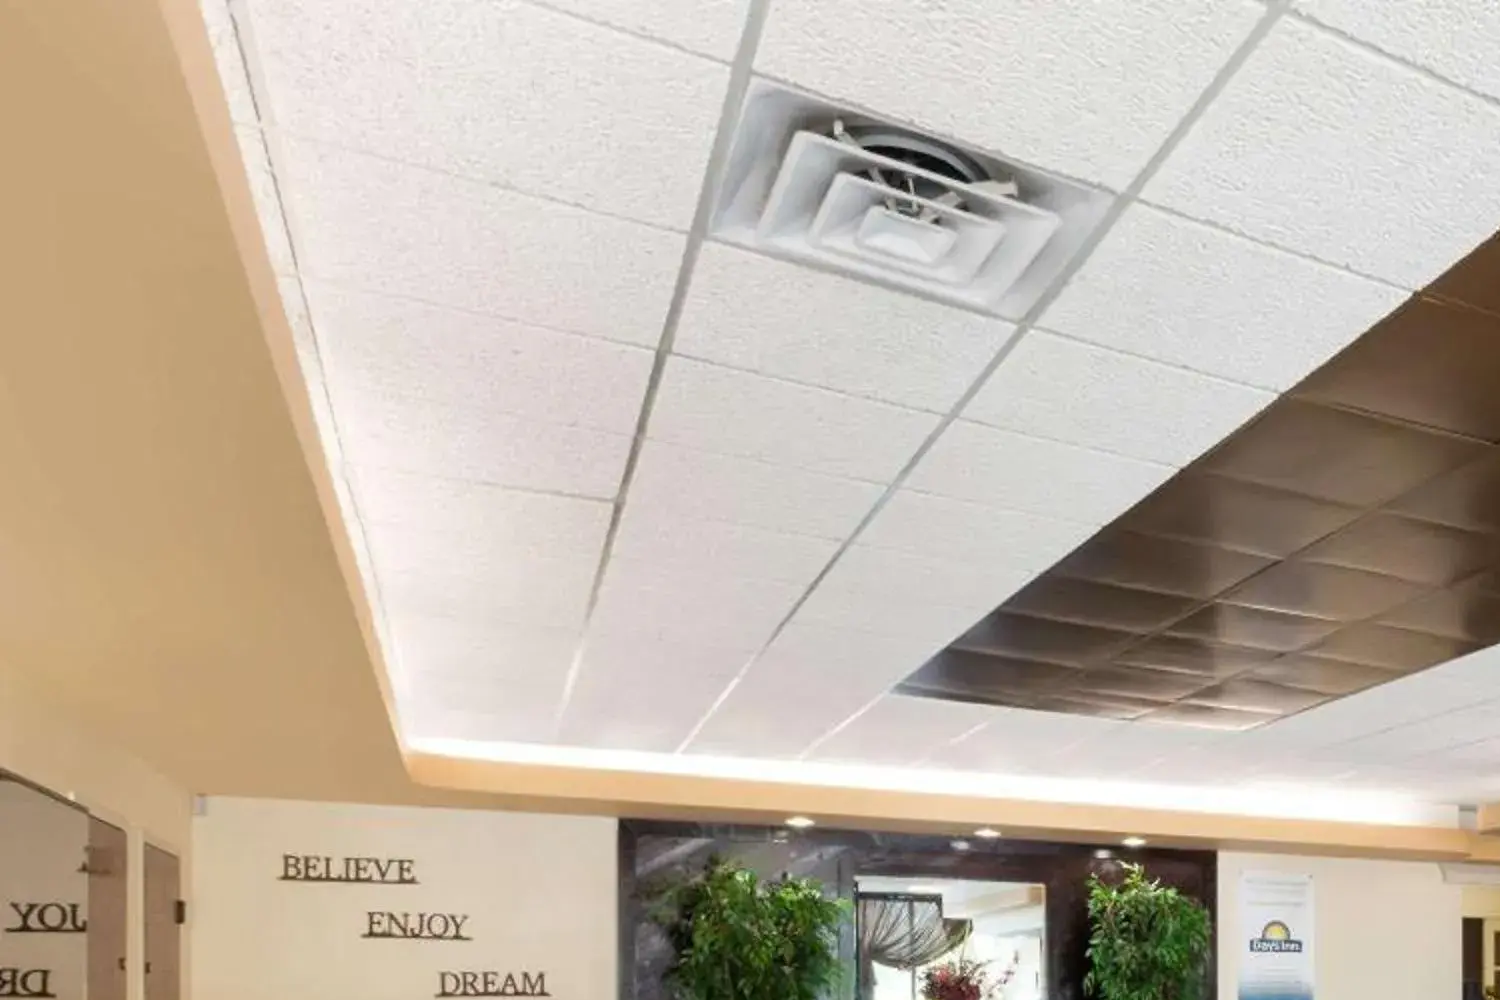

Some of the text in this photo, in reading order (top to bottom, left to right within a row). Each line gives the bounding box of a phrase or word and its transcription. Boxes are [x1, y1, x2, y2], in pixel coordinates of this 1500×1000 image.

[281, 854, 417, 884] BELIEVE
[364, 911, 471, 940] ENJOY
[438, 971, 549, 997] DREAM
